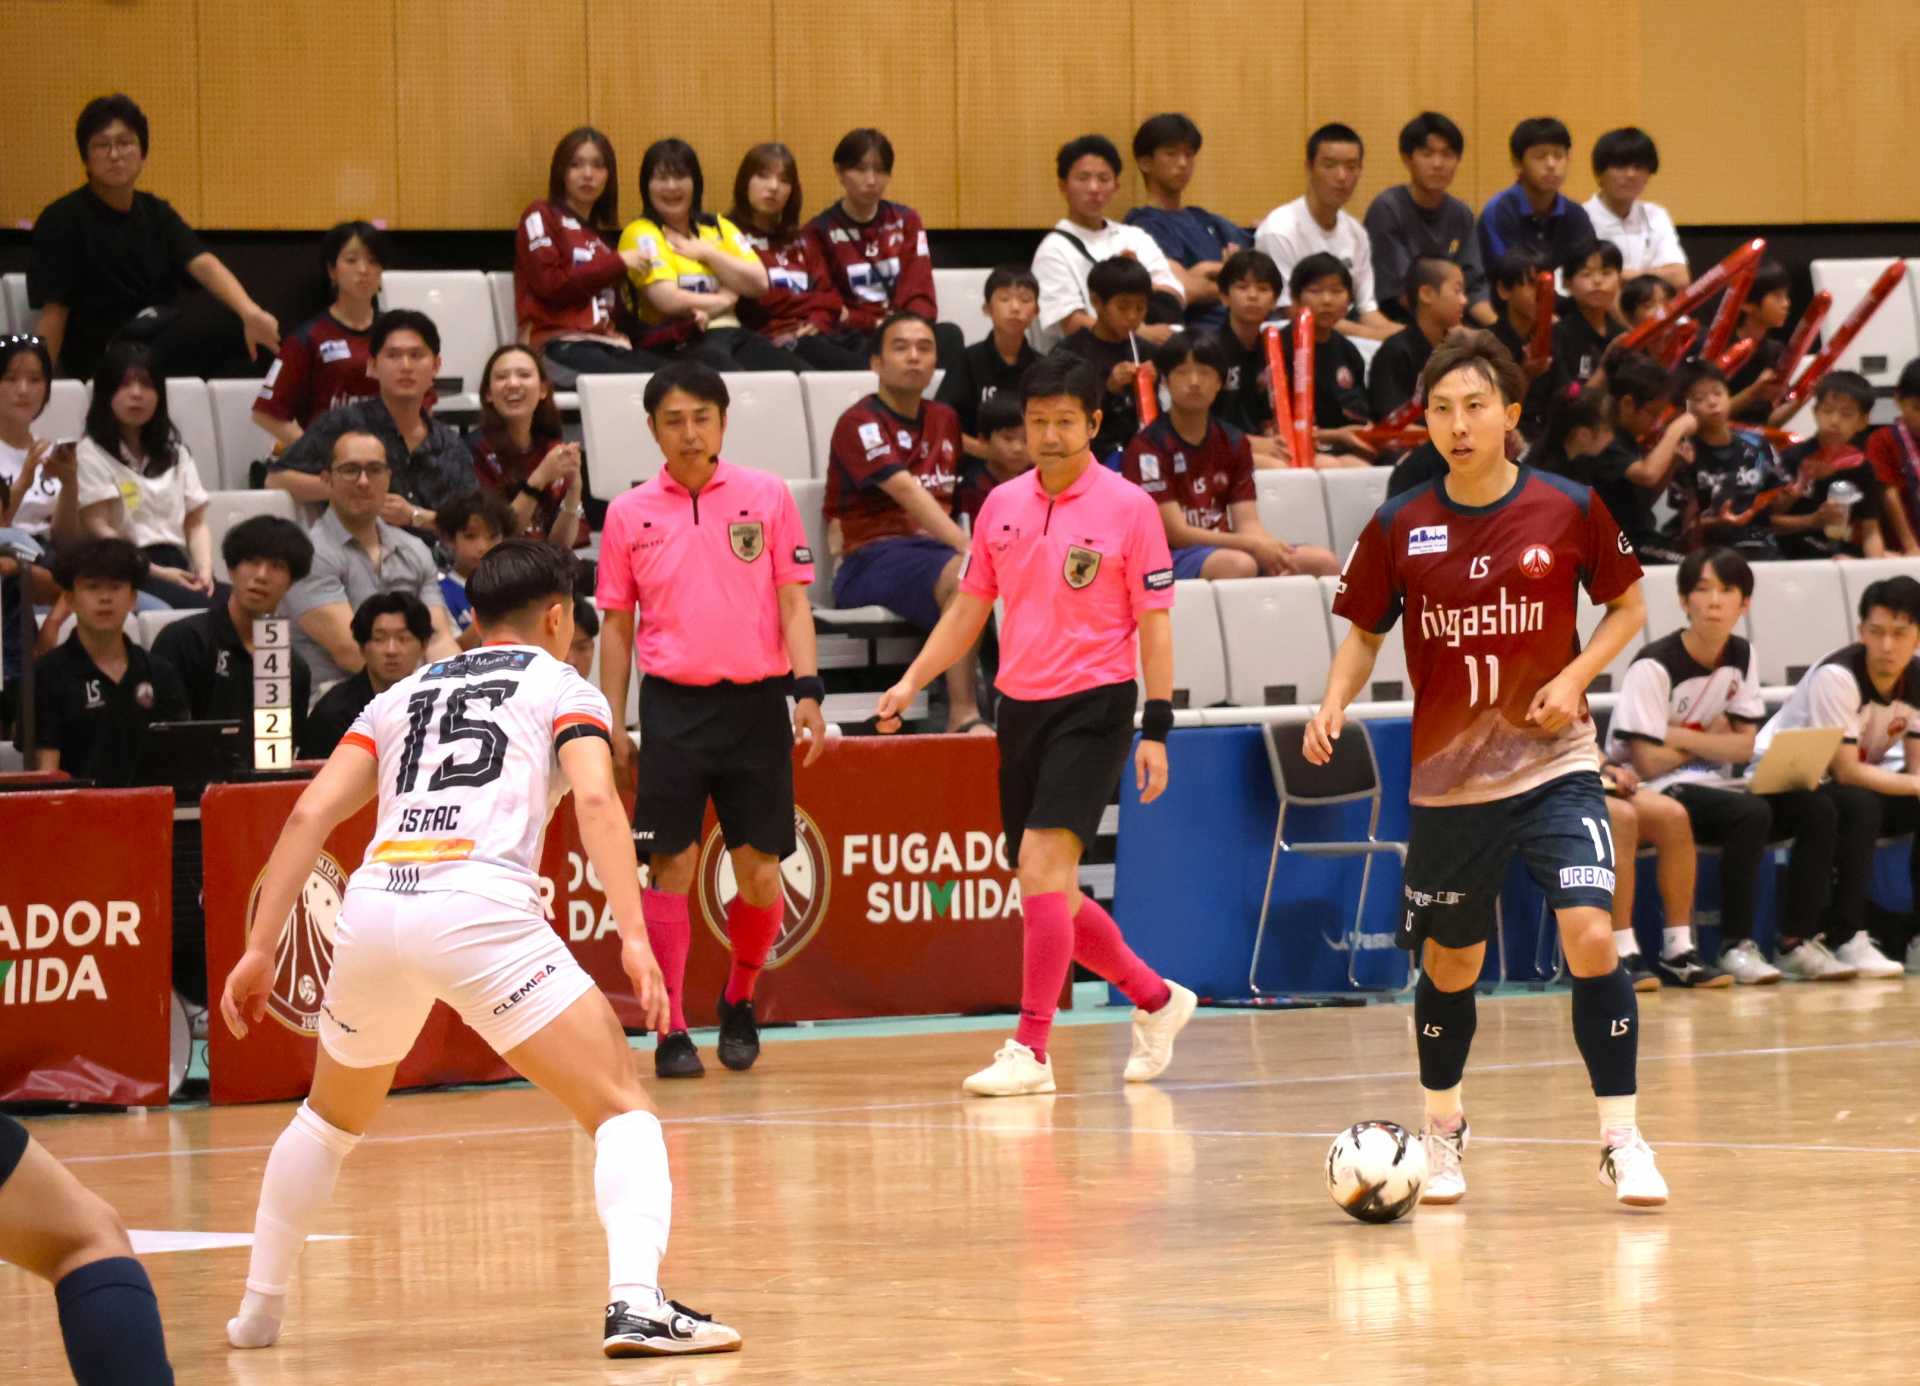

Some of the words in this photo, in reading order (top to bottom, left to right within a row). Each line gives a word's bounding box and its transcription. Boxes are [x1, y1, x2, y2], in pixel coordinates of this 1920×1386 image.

[1469, 555, 1491, 579] LS
[1421, 586, 1544, 647] higashin
[265, 623, 278, 643] 5
[263, 653, 279, 674] 4
[1464, 655, 1499, 708] 11
[265, 683, 279, 704] 3
[265, 713, 279, 734] 2
[395, 678, 519, 797] 15
[266, 743, 278, 764] 1
[1581, 816, 1615, 868] 11
[865, 877, 1025, 924] SUMIDA
[493, 964, 557, 1016] CLEMIRA
[1422, 1023, 1444, 1038] LS
[1611, 1017, 1630, 1037] LS
